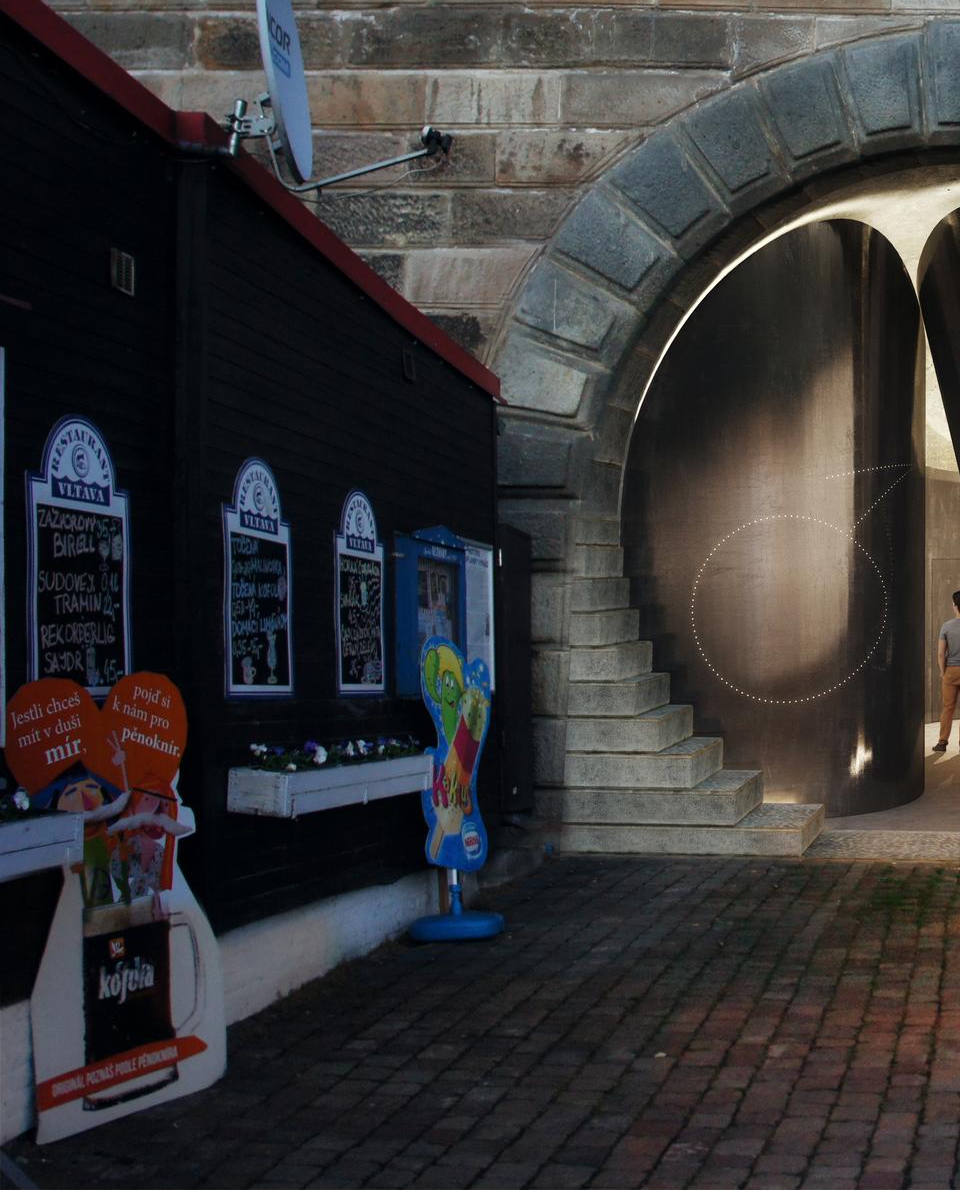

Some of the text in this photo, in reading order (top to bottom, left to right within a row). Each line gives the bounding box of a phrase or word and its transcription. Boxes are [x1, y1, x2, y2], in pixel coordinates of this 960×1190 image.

[51, 428, 111, 483] RESTAURANT
[58, 481, 104, 503] VLTAVA
[243, 514, 275, 532] VLTAVA
[53, 532, 95, 558] BIRELL
[11, 691, 81, 730] Jestli chceš
[112, 695, 170, 730] k nám pro
[133, 686, 171, 709] pojď si
[18, 714, 81, 749] mít v duši
[121, 726, 181, 758] pěnoknír.
[44, 736, 87, 765] mír,
